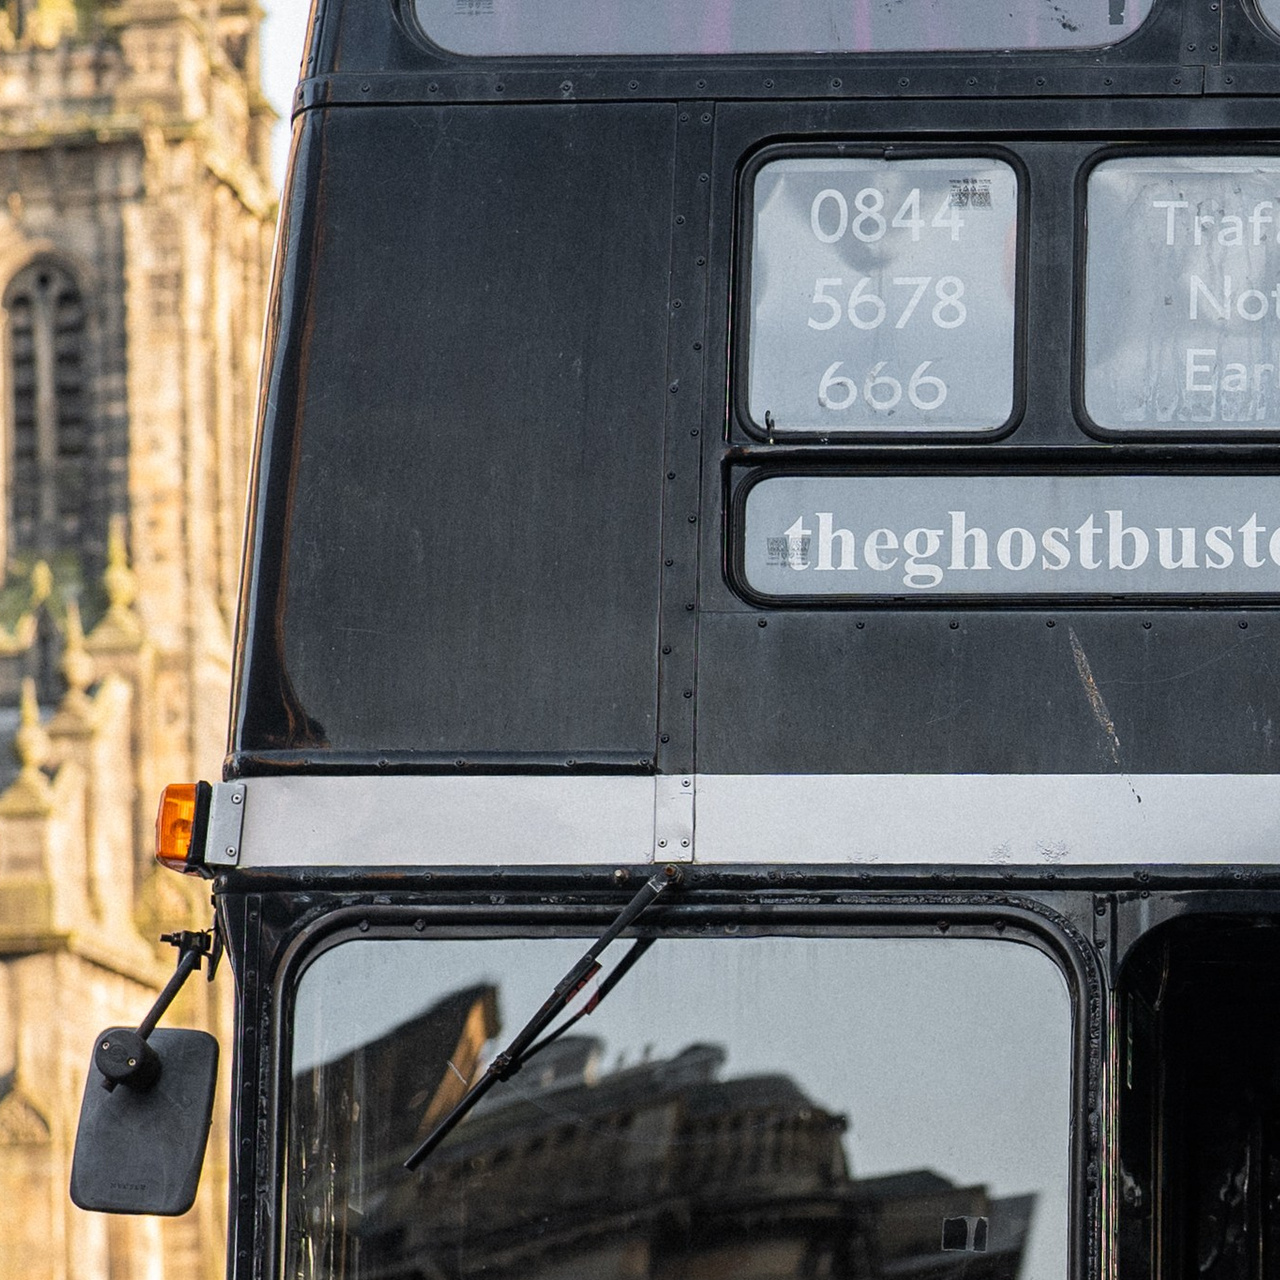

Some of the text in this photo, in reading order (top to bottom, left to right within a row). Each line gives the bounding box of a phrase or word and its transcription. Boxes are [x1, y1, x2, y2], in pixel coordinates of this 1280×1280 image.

[810, 187, 965, 244] 0844
[807, 275, 967, 331] 5678
[818, 360, 948, 410] 666
